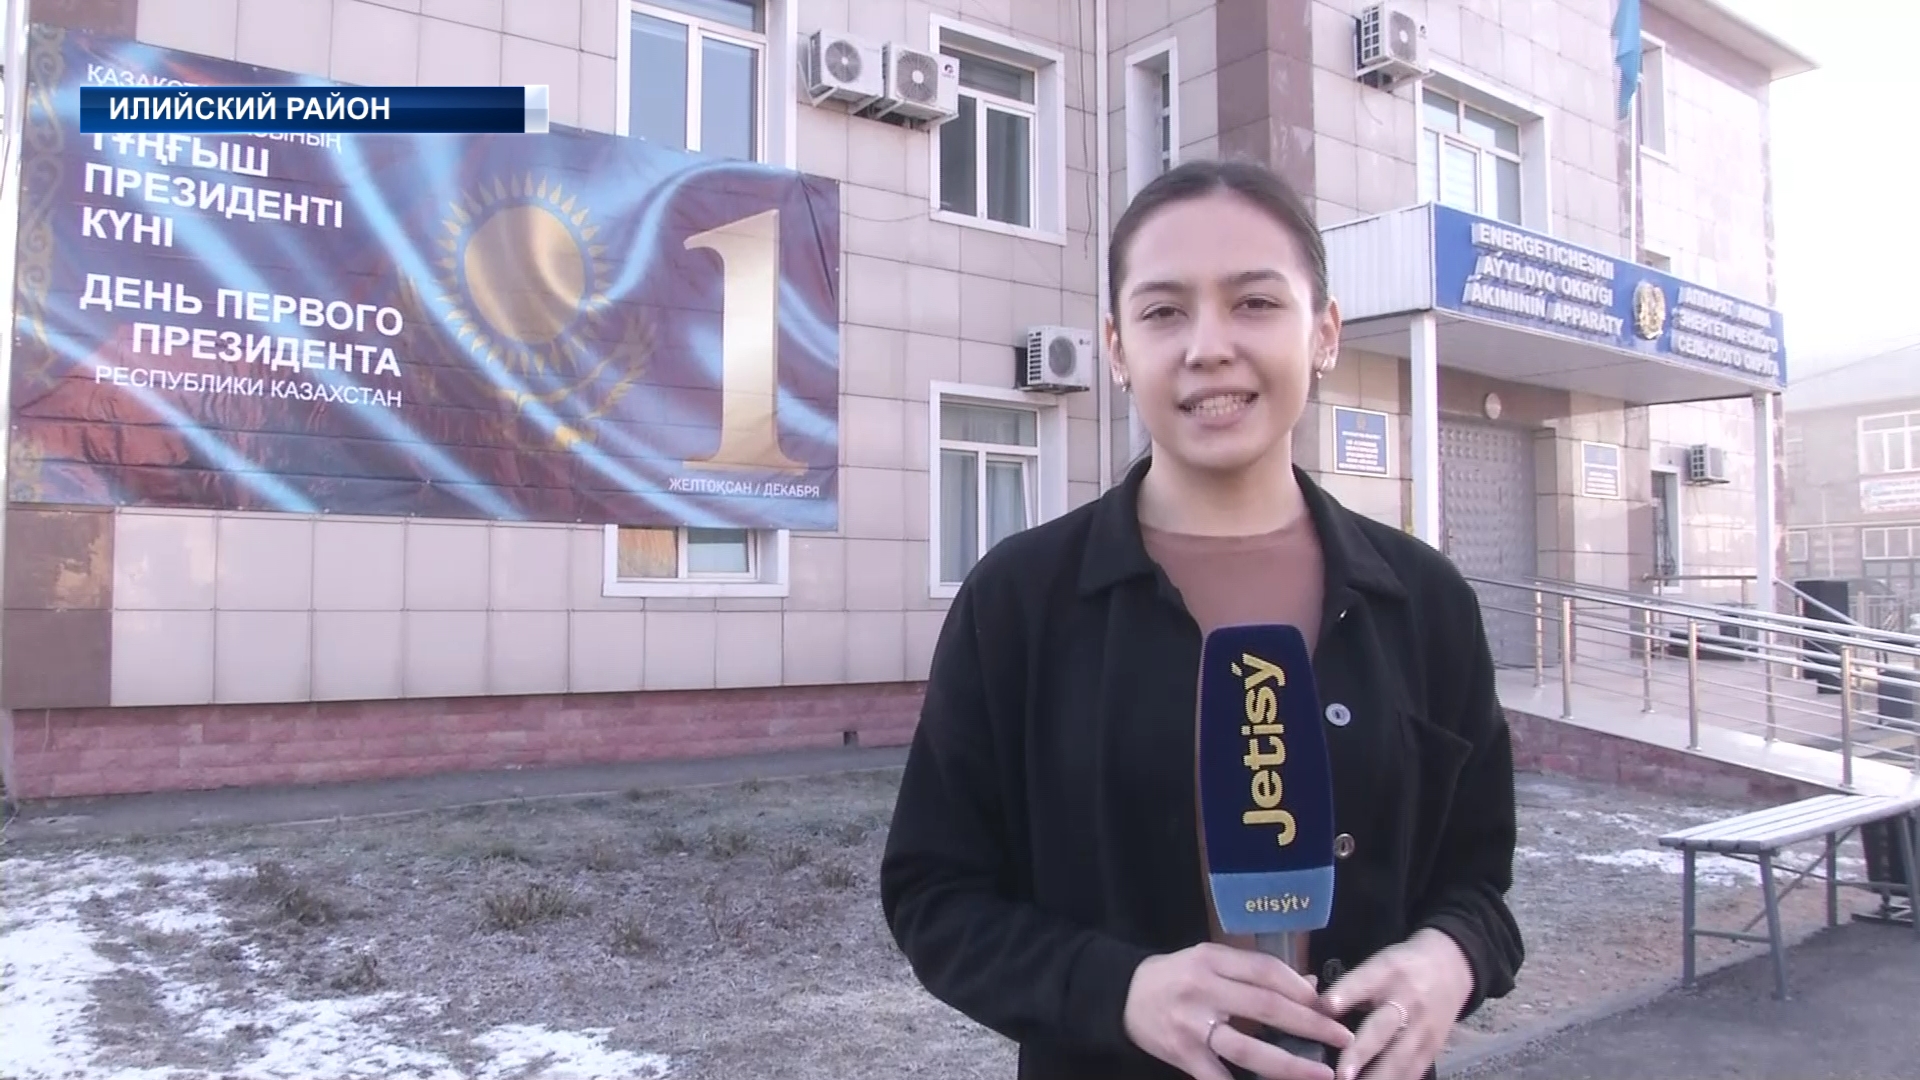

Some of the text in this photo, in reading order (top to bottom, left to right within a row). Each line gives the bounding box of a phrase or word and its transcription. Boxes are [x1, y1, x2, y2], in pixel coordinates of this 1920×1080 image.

[84, 162, 343, 228] ПРЕЗИДЕНТІ
[82, 206, 173, 248] КҮНІ
[79, 273, 404, 337] ДЕНЬ ПЕРВОГО
[1551, 301, 1624, 336] APPARATY
[131, 322, 402, 377] ПРЕЗИДЕНТА
[683, 208, 809, 476] 1
[95, 366, 402, 408] РЕСПУБЛИКИ КАЗАХСТАН
[668, 477, 752, 495] ЖЕЛТОҚСАН
[763, 483, 820, 498] ДЕКАБРЯ
[1230, 653, 1297, 847] Jetisý
